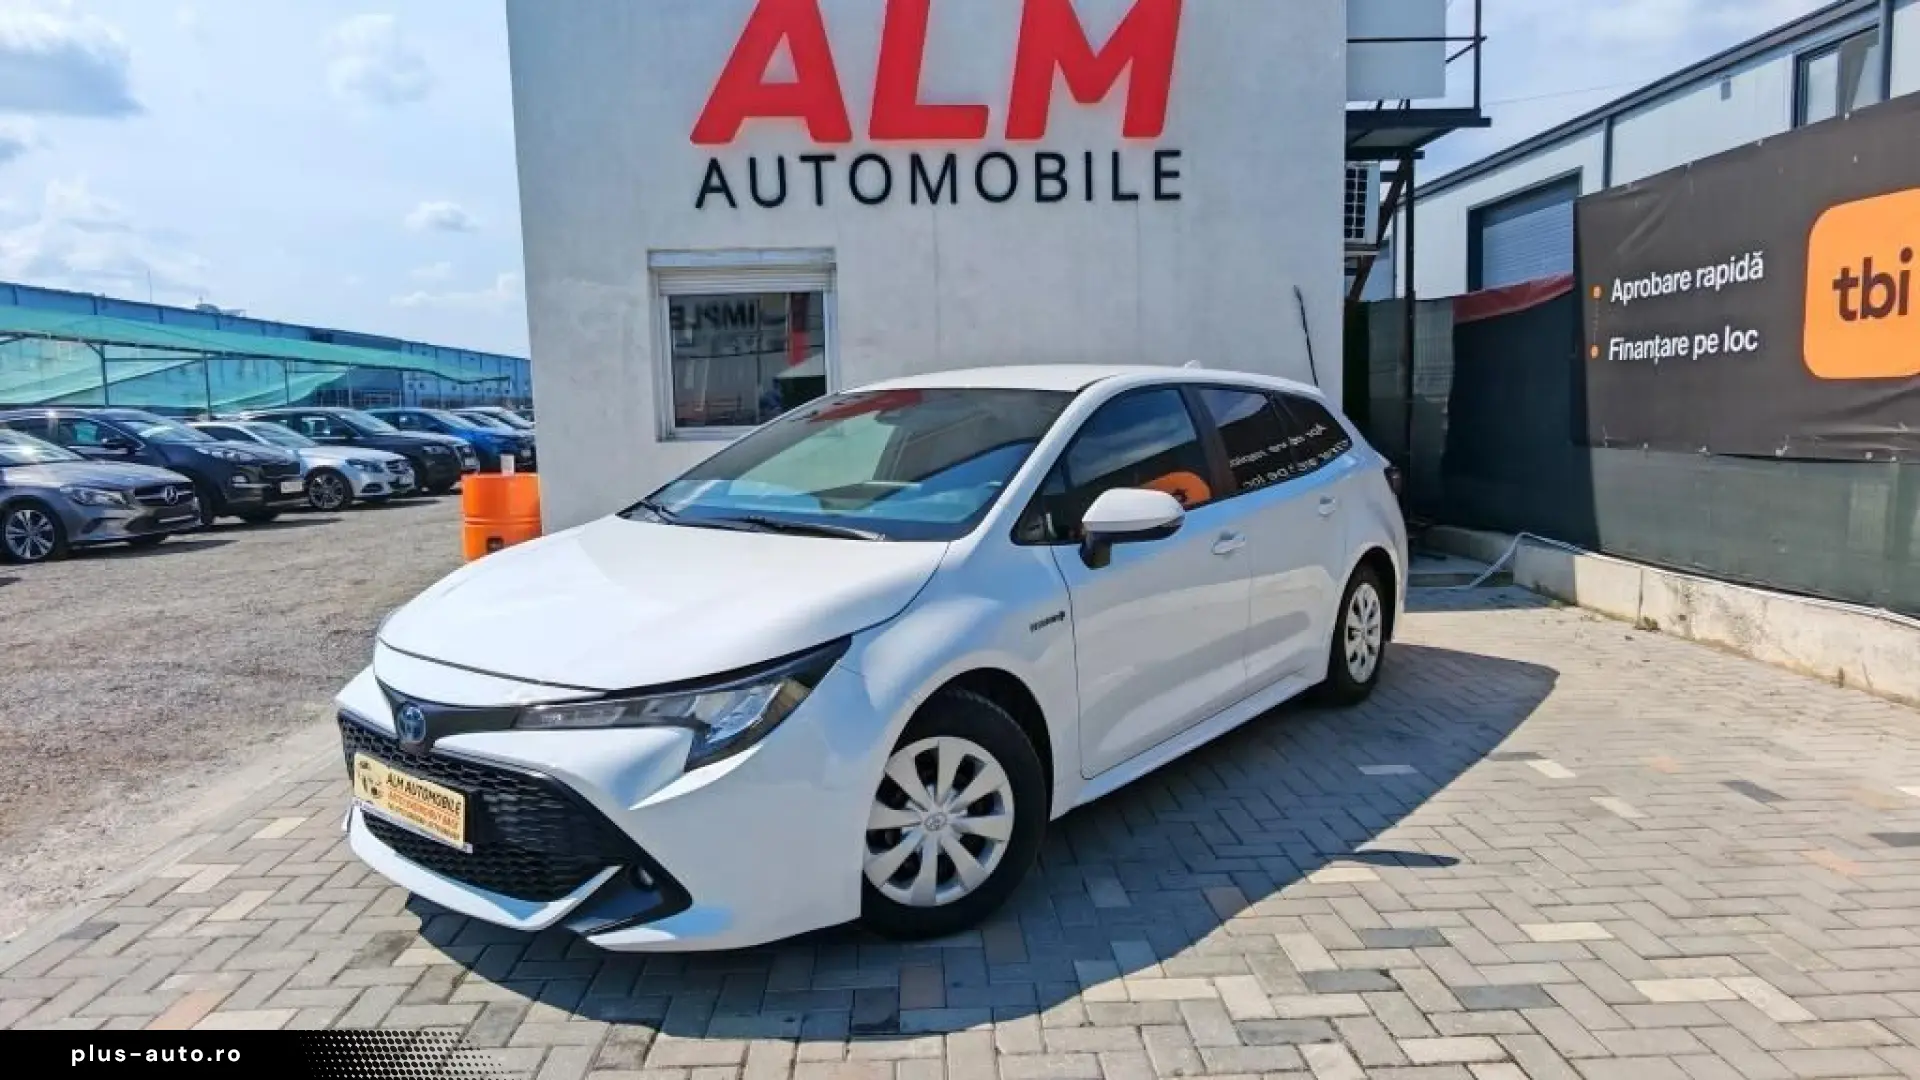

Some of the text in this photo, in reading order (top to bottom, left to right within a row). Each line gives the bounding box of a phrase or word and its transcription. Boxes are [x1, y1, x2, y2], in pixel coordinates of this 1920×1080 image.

[690, 0, 1182, 143] ALM
[695, 150, 1182, 209] AUTOMOBILE
[1610, 251, 1764, 306] Aprobare rapidă
[1832, 247, 1913, 321] tbi
[1609, 326, 1760, 364] Finanțare pe loc
